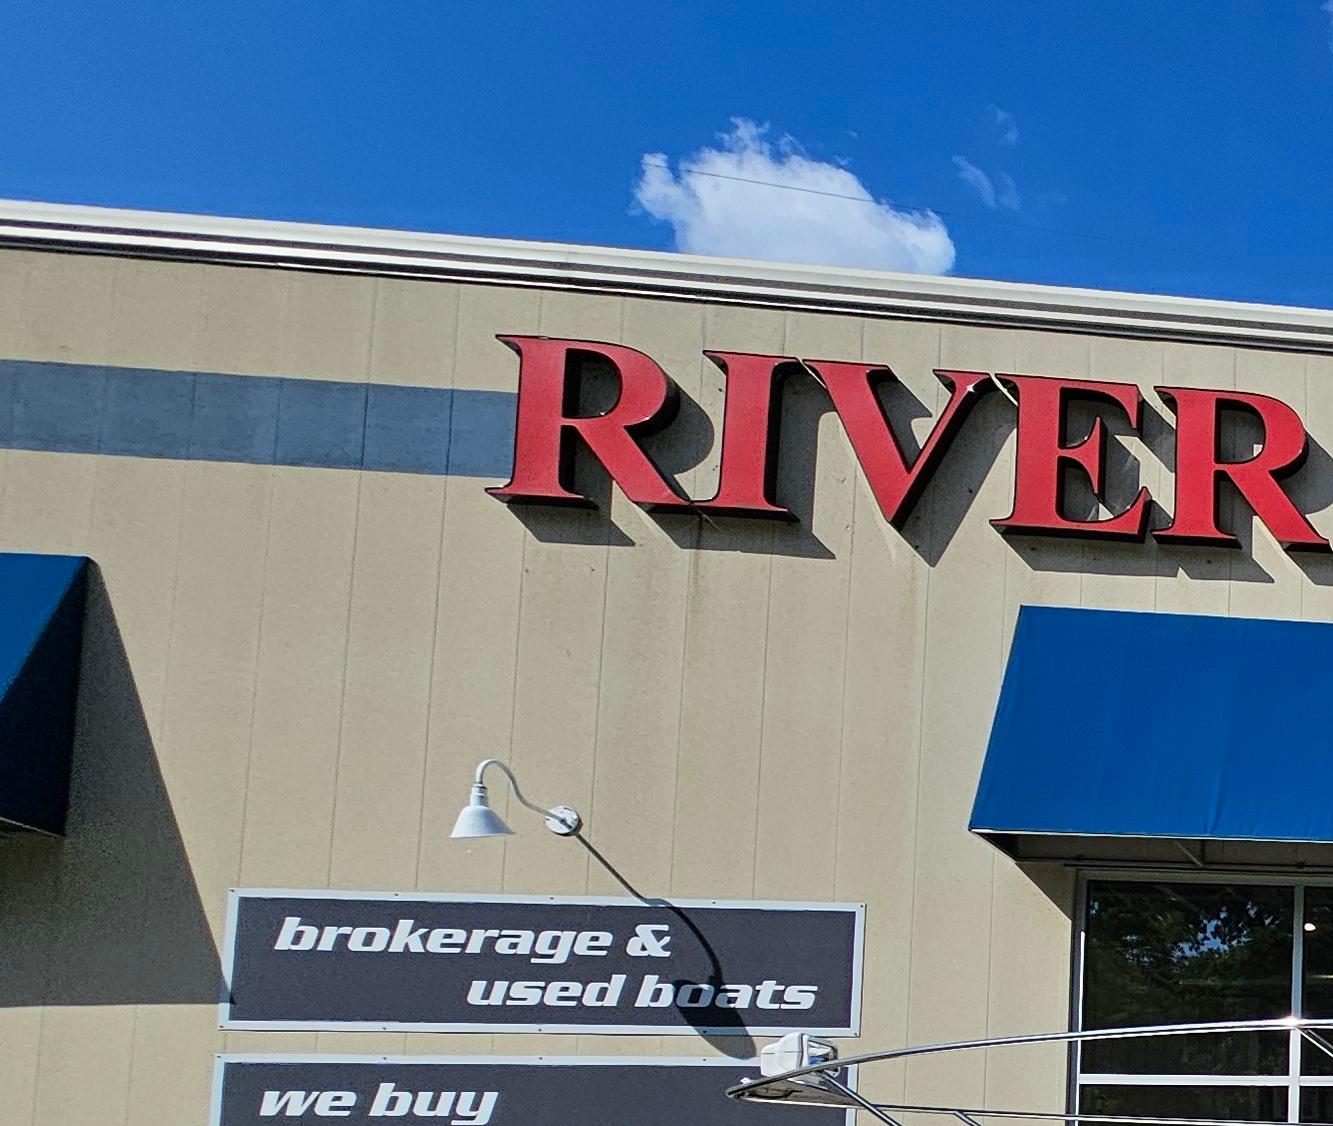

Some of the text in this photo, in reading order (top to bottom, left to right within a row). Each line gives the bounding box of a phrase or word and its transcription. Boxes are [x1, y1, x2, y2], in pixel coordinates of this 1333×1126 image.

[486, 333, 1332, 554] RIVER
[274, 917, 672, 964] brokerage &
[465, 974, 819, 1010] used boats
[259, 1082, 499, 1126] we buy
